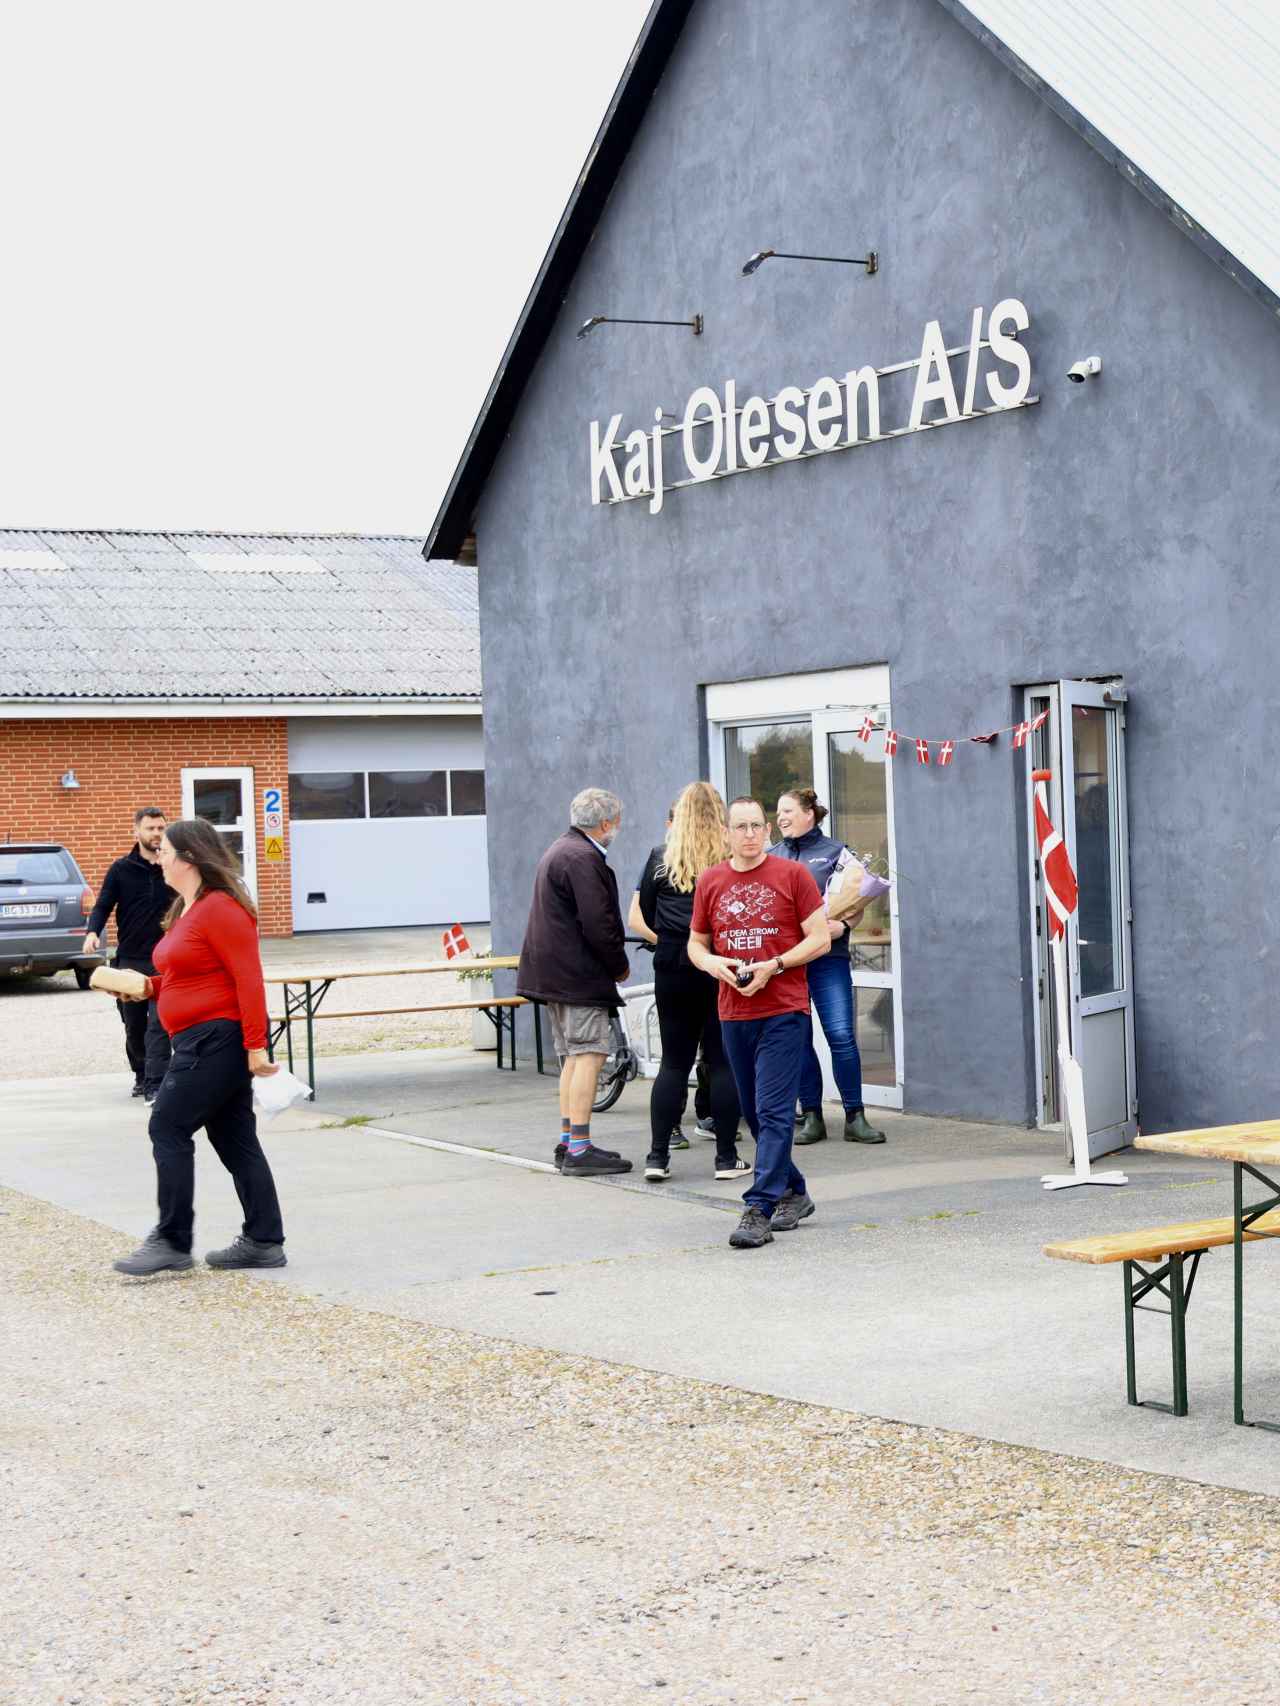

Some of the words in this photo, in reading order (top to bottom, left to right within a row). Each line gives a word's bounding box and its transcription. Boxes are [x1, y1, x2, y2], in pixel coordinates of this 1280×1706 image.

[589, 406, 663, 515] Kaj
[682, 365, 881, 481] Olesen
[908, 298, 1032, 431] A/S
[265, 790, 280, 812] 2
[730, 929, 748, 938] DEM
[749, 927, 779, 936] STROM?
